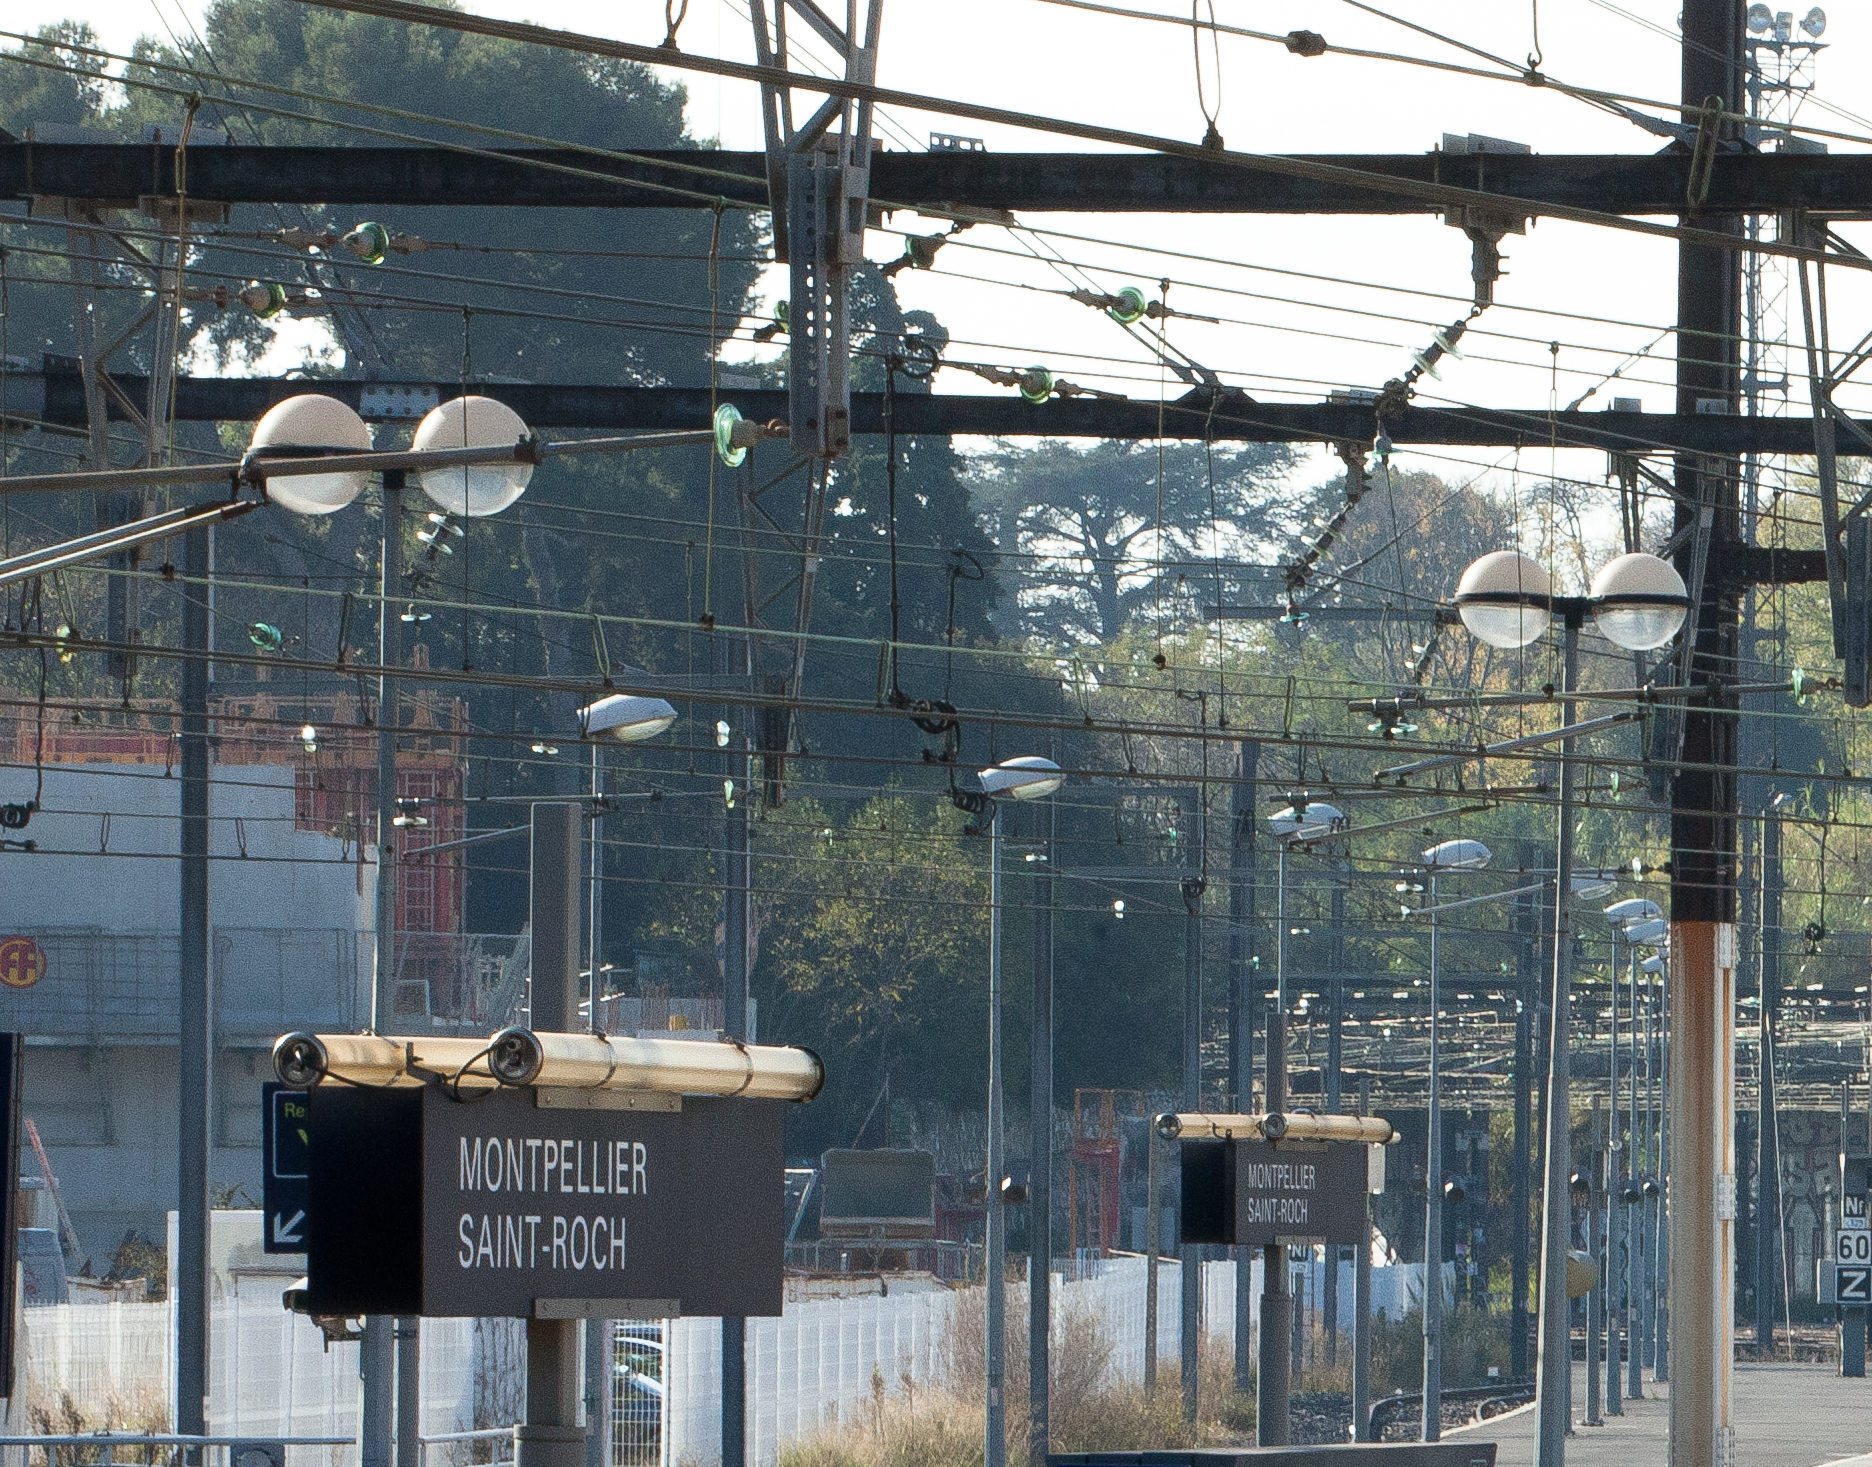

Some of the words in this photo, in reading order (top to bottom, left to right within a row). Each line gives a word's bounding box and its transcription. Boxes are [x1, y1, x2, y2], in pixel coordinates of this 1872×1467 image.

[458, 1136, 648, 1195] MONTPELLIER
[1248, 1163, 1316, 1190] MONTPELLIER
[1247, 1197, 1308, 1224] SAINT-ROCH
[458, 1214, 627, 1271] SAINT-ROCH
[1839, 1234, 1870, 1260] 60
[1841, 1270, 1867, 1299] Z
